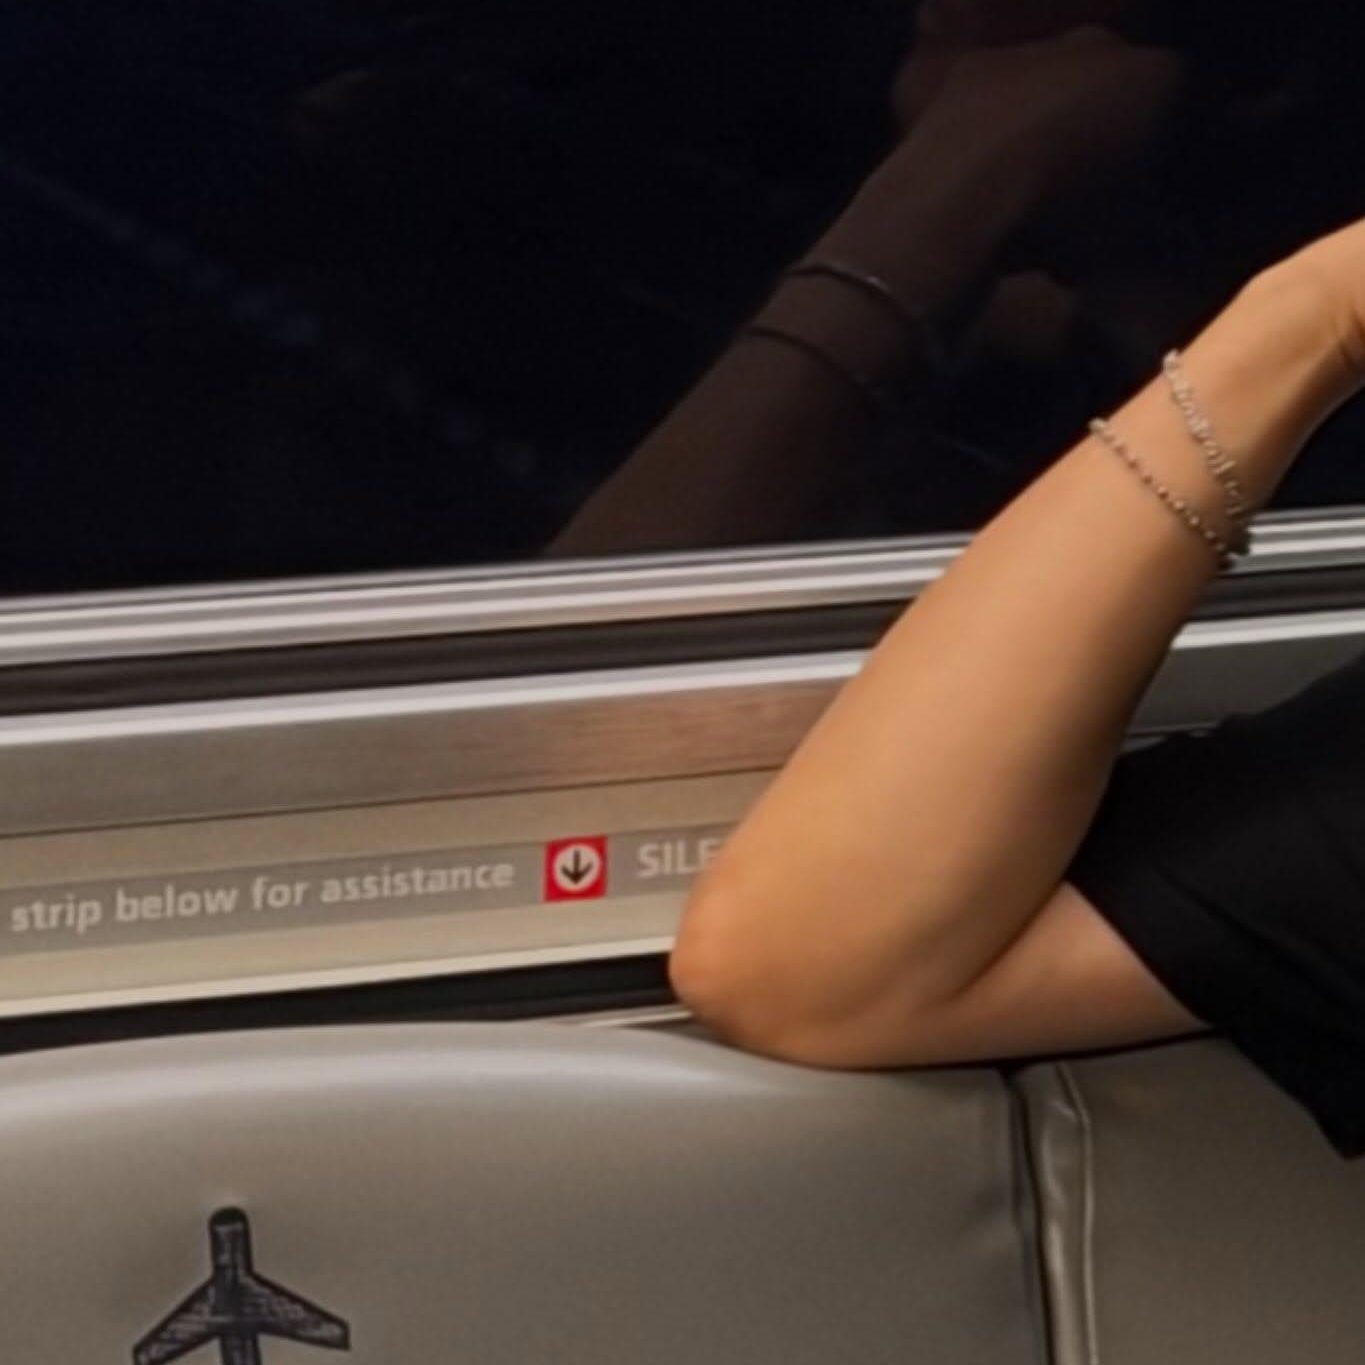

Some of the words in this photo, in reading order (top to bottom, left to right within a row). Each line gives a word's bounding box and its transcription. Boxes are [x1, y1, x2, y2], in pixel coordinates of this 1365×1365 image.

[11, 892, 102, 936] strip
[115, 884, 239, 923] below
[252, 876, 310, 911] for
[320, 863, 516, 905] assistance
